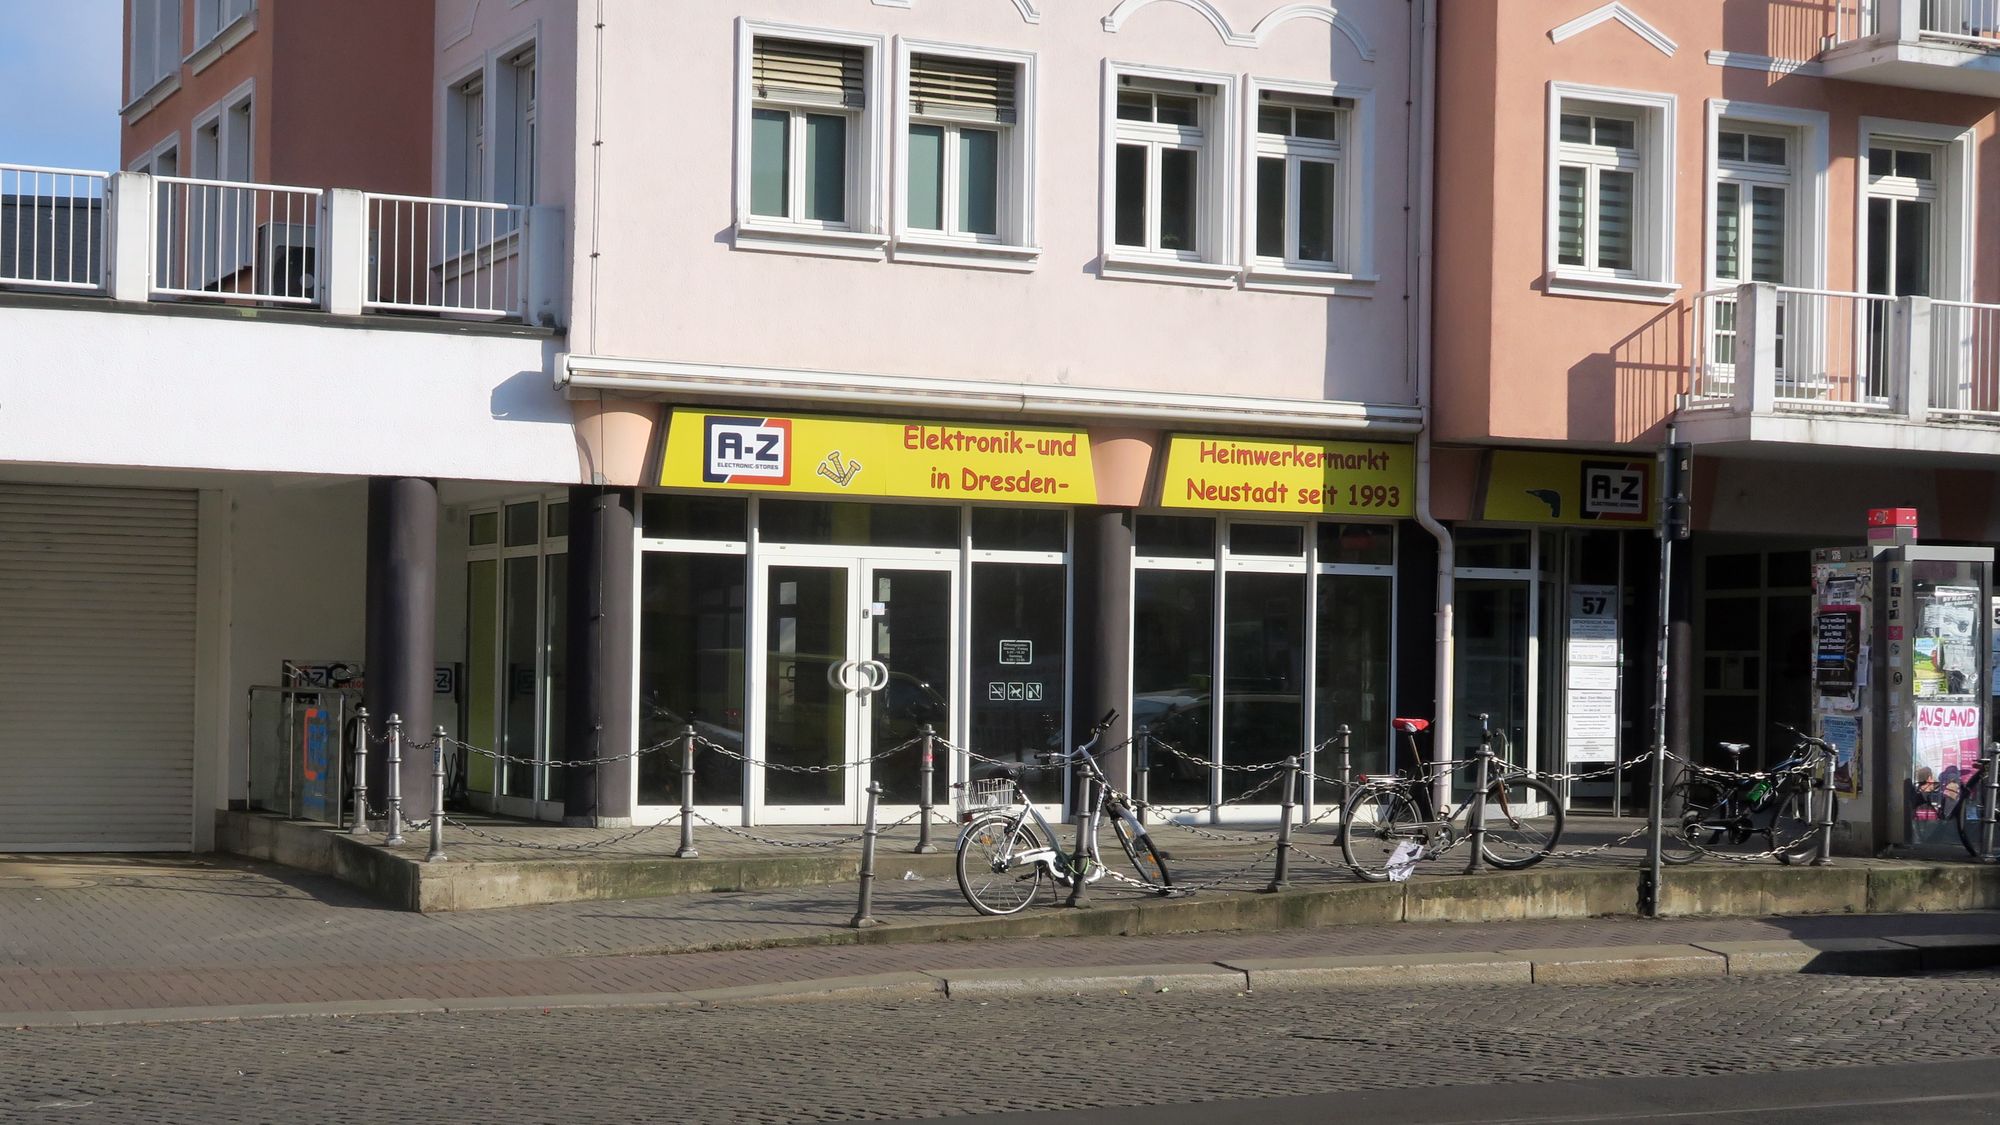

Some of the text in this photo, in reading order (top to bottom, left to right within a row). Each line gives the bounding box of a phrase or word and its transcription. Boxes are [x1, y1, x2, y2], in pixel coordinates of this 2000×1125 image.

[718, 432, 779, 462] A-Z
[904, 425, 1077, 457] Elektronik-und
[717, 462, 779, 470] ELECTRONIC-STORES
[1200, 441, 1390, 471] Heimwerkermarkt
[930, 466, 1069, 494] in Dresden-
[1186, 478, 1400, 507] Neustadt seit 1993
[1591, 475, 1639, 500] A-Z
[1582, 597, 1607, 615] 57
[1918, 707, 1976, 727] AUSLAND
